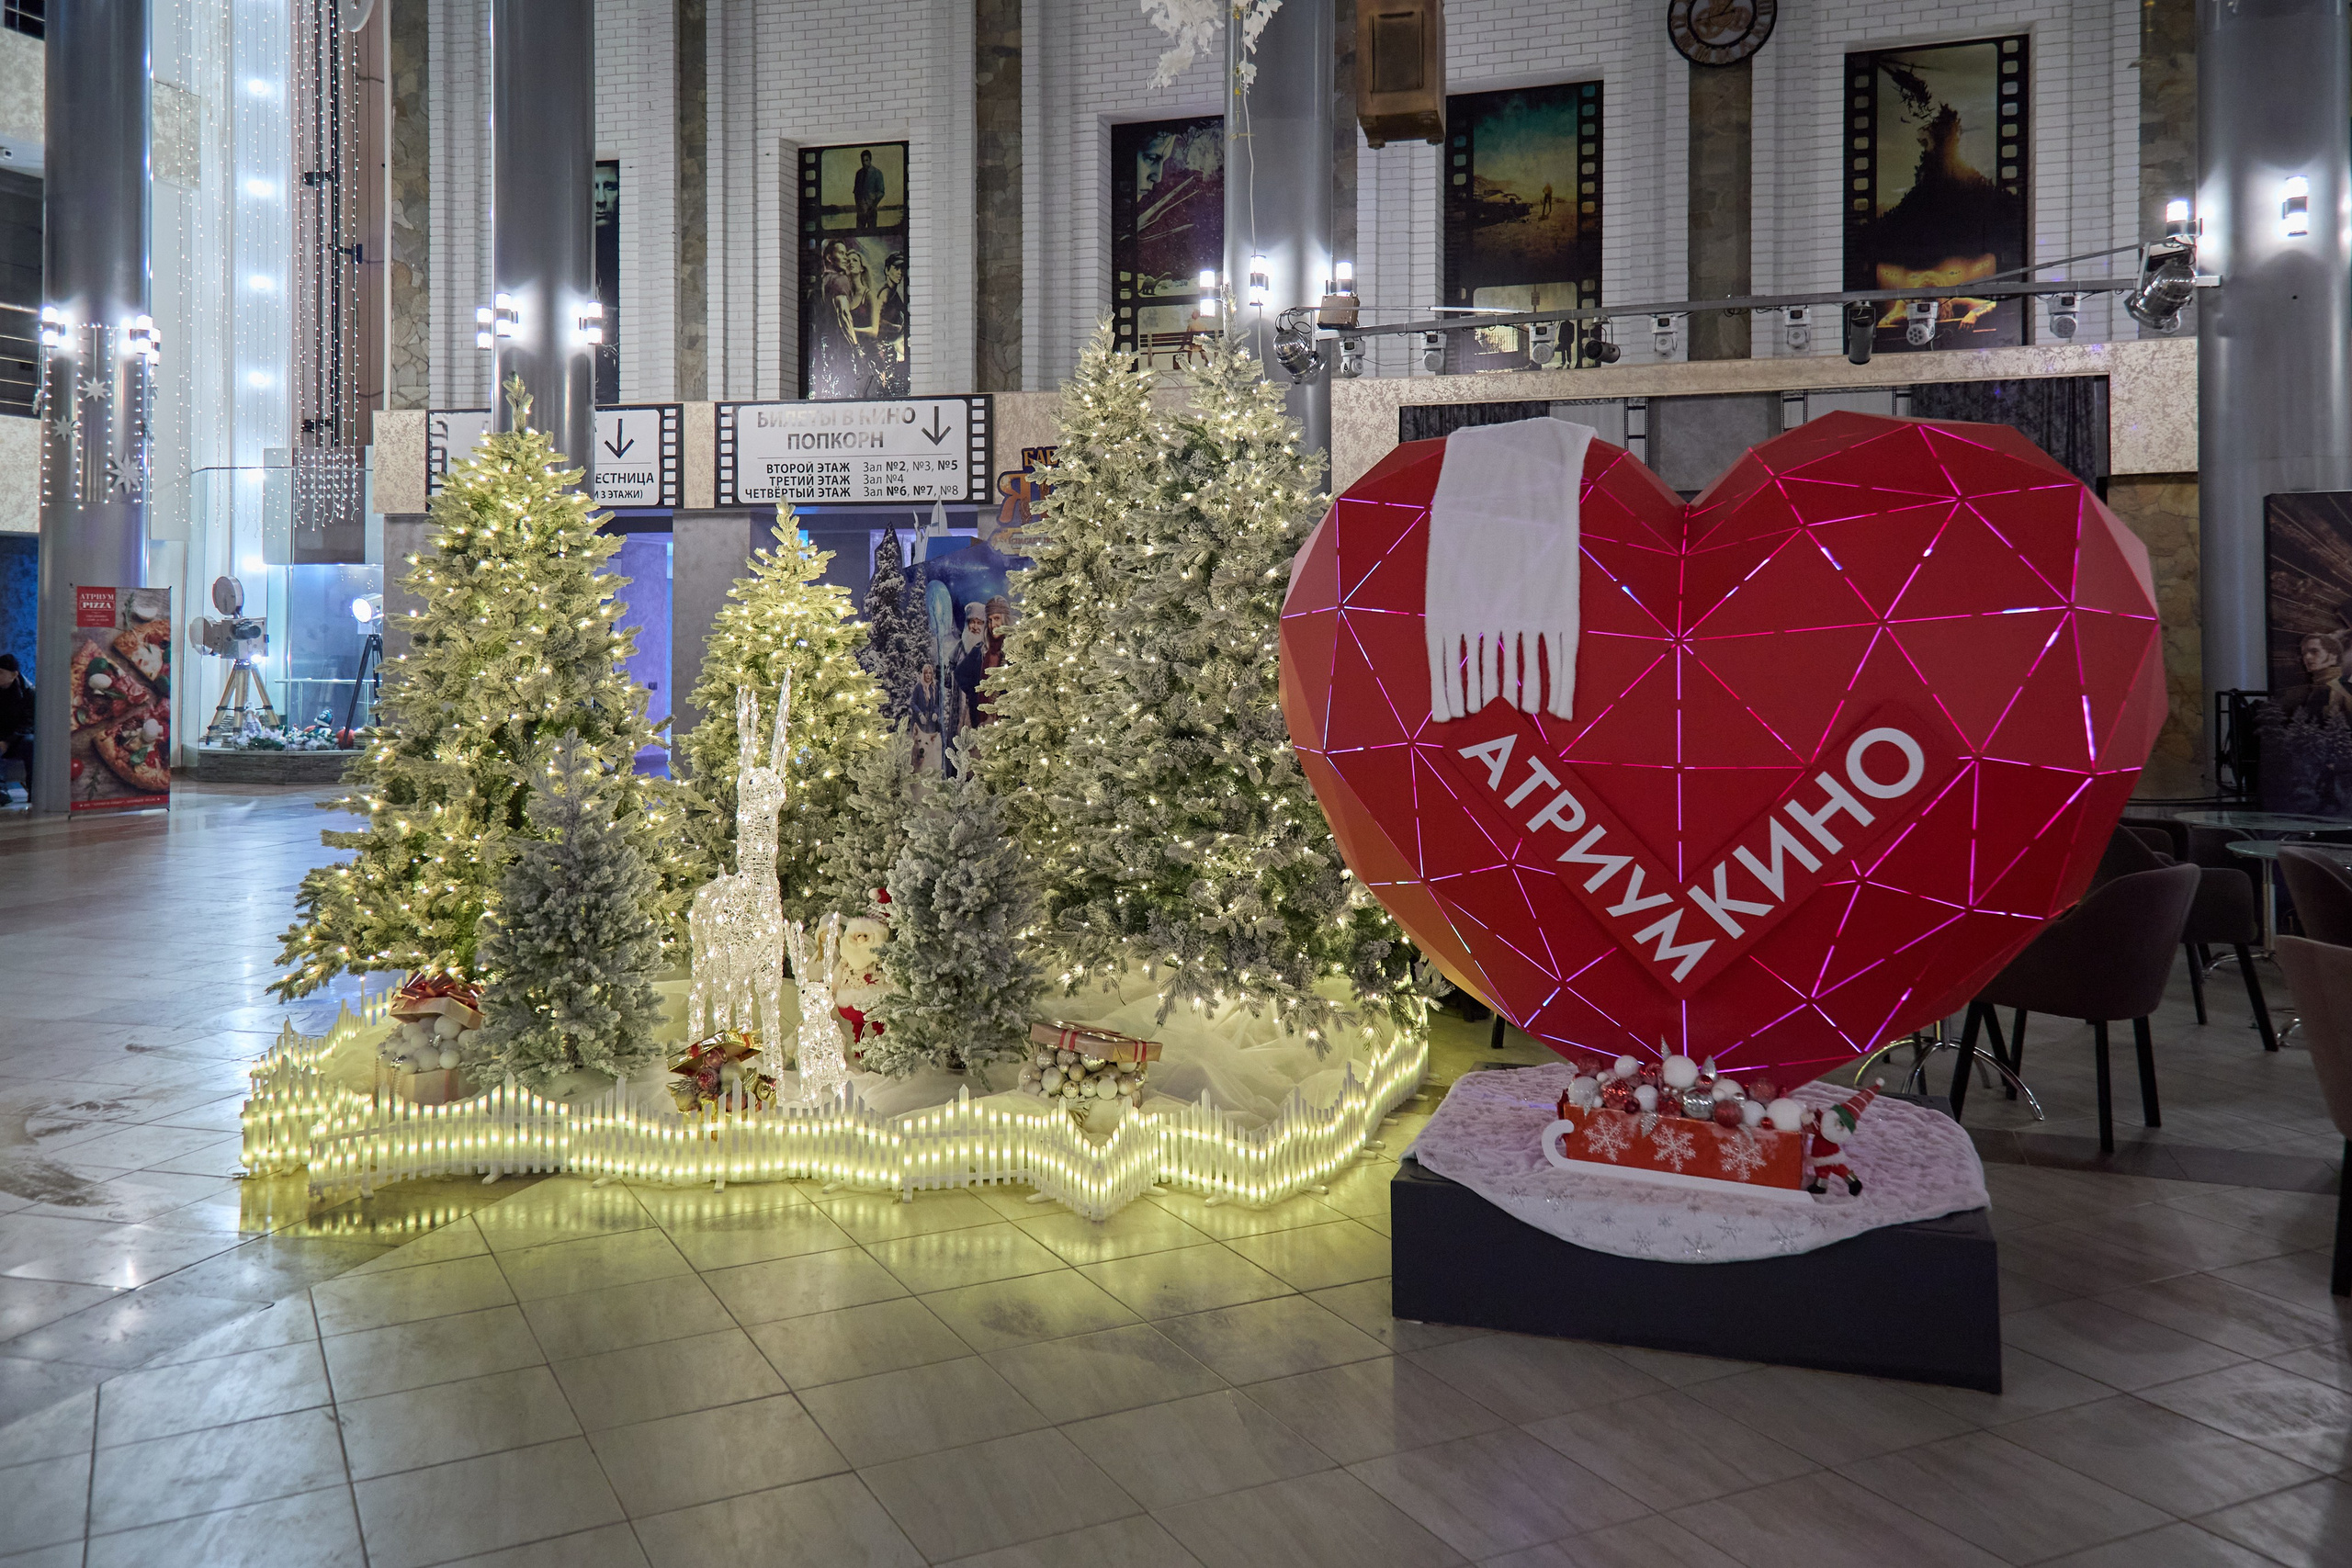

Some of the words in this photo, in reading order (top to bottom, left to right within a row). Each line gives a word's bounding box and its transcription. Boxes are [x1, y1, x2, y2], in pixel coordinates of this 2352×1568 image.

[757, 409, 836, 428] БИЛЕТЫ
[842, 411, 854, 426] В
[860, 407, 916, 426] КИНО
[787, 431, 884, 450] ПОПКОРН
[766, 461, 814, 474] ВТОРОЙ
[817, 462, 851, 473] ЭТАЖ
[863, 462, 883, 473] Зал
[937, 460, 958, 471] №5
[595, 472, 654, 486] ЕСТНИЦА
[769, 474, 814, 486] ТРЕТИЙ
[817, 475, 851, 485] ЭТАЖ
[863, 474, 883, 485] Зал
[886, 474, 904, 484] №4
[601, 491, 606, 499] 3
[608, 490, 643, 499] ЭТАЖИ)
[745, 486, 814, 499] ЧЕТВЁРТЫЙ
[817, 487, 851, 498] ЭТАЖ
[864, 486, 883, 497] Зал
[940, 485, 959, 496] №8
[1457, 733, 1716, 984] АТРИУМ
[1687, 727, 1925, 940] КИНО
